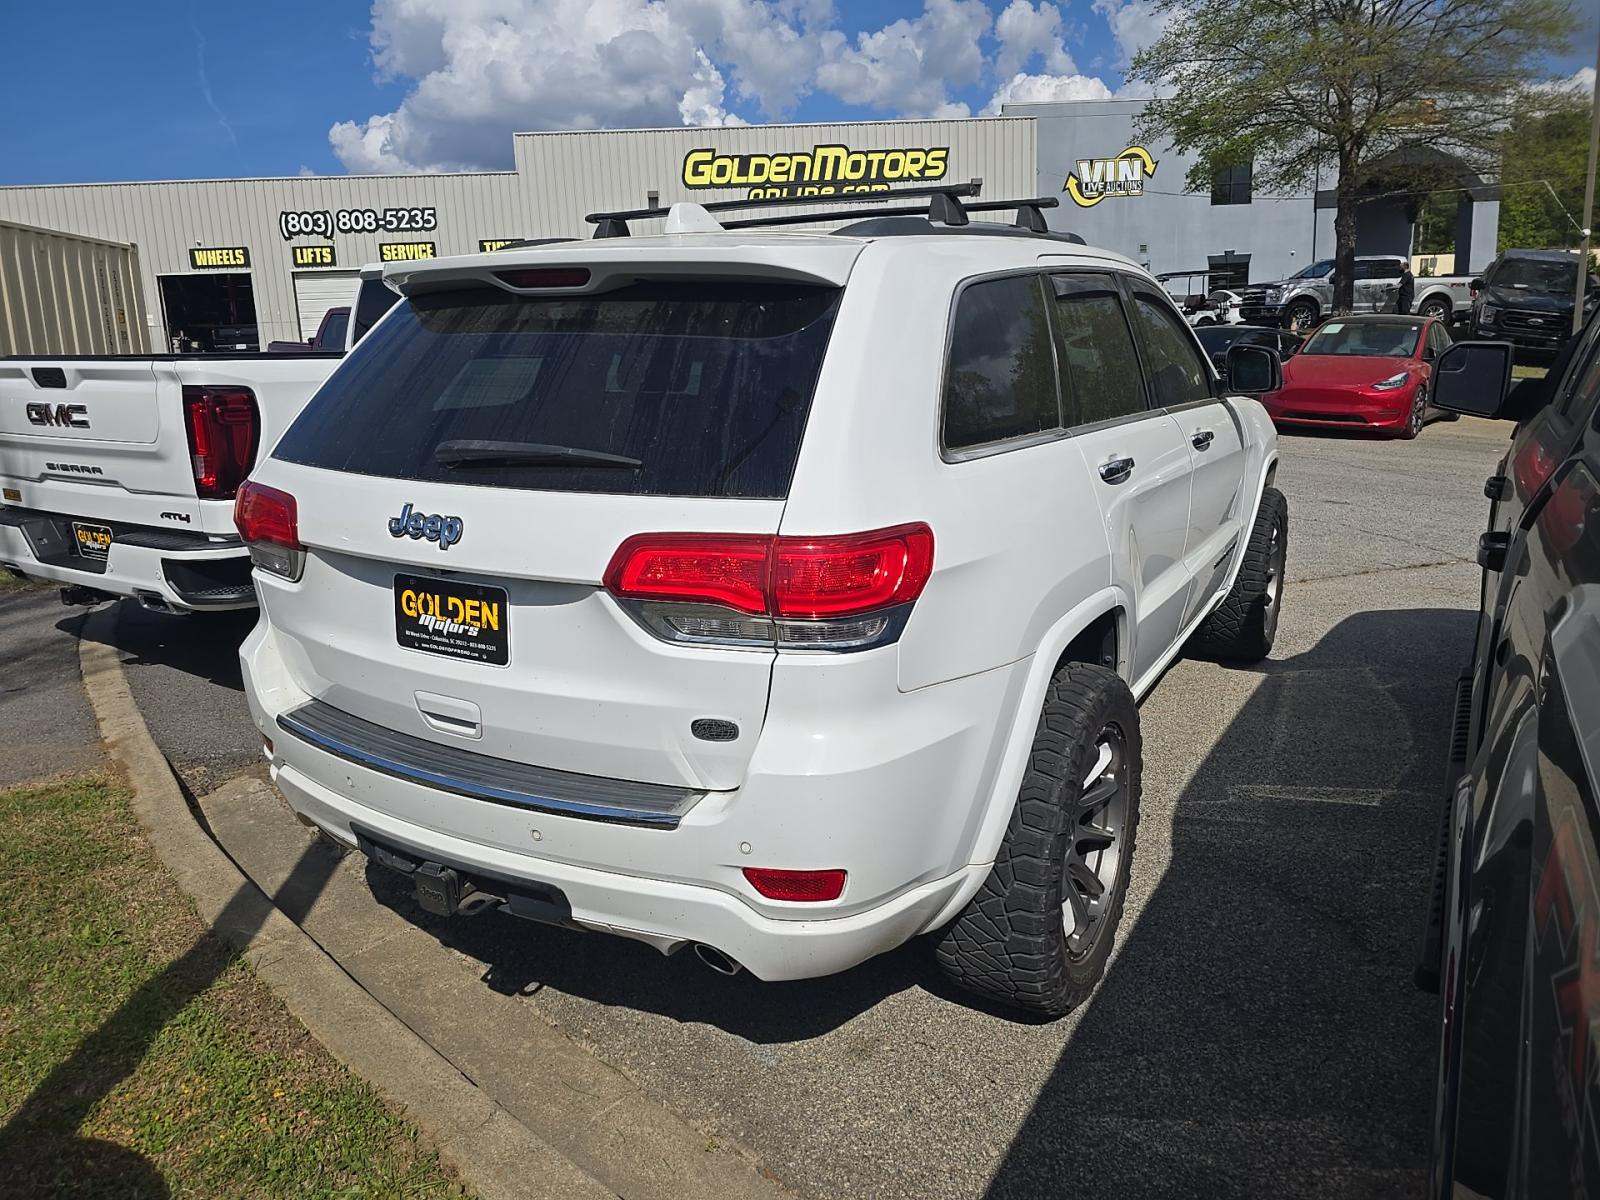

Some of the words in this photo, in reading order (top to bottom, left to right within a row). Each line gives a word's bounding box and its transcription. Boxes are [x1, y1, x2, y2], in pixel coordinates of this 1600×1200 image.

[1077, 159, 1143, 197] VIN
[1083, 182, 1105, 192] LIVE
[1106, 181, 1142, 192] AUCTIONS
[280, 211, 333, 239] (803)
[337, 209, 436, 230] 808-5235
[194, 249, 245, 266] WHEELS
[296, 247, 332, 264] LIFTS
[382, 243, 434, 261] SERVICE
[26, 402, 90, 428] GMC
[46, 462, 103, 475] SIERRA
[160, 512, 190, 523] AT4
[388, 502, 463, 550] Jeep
[77, 529, 111, 545] GOLDEN
[401, 589, 499, 631] GOLDEN
